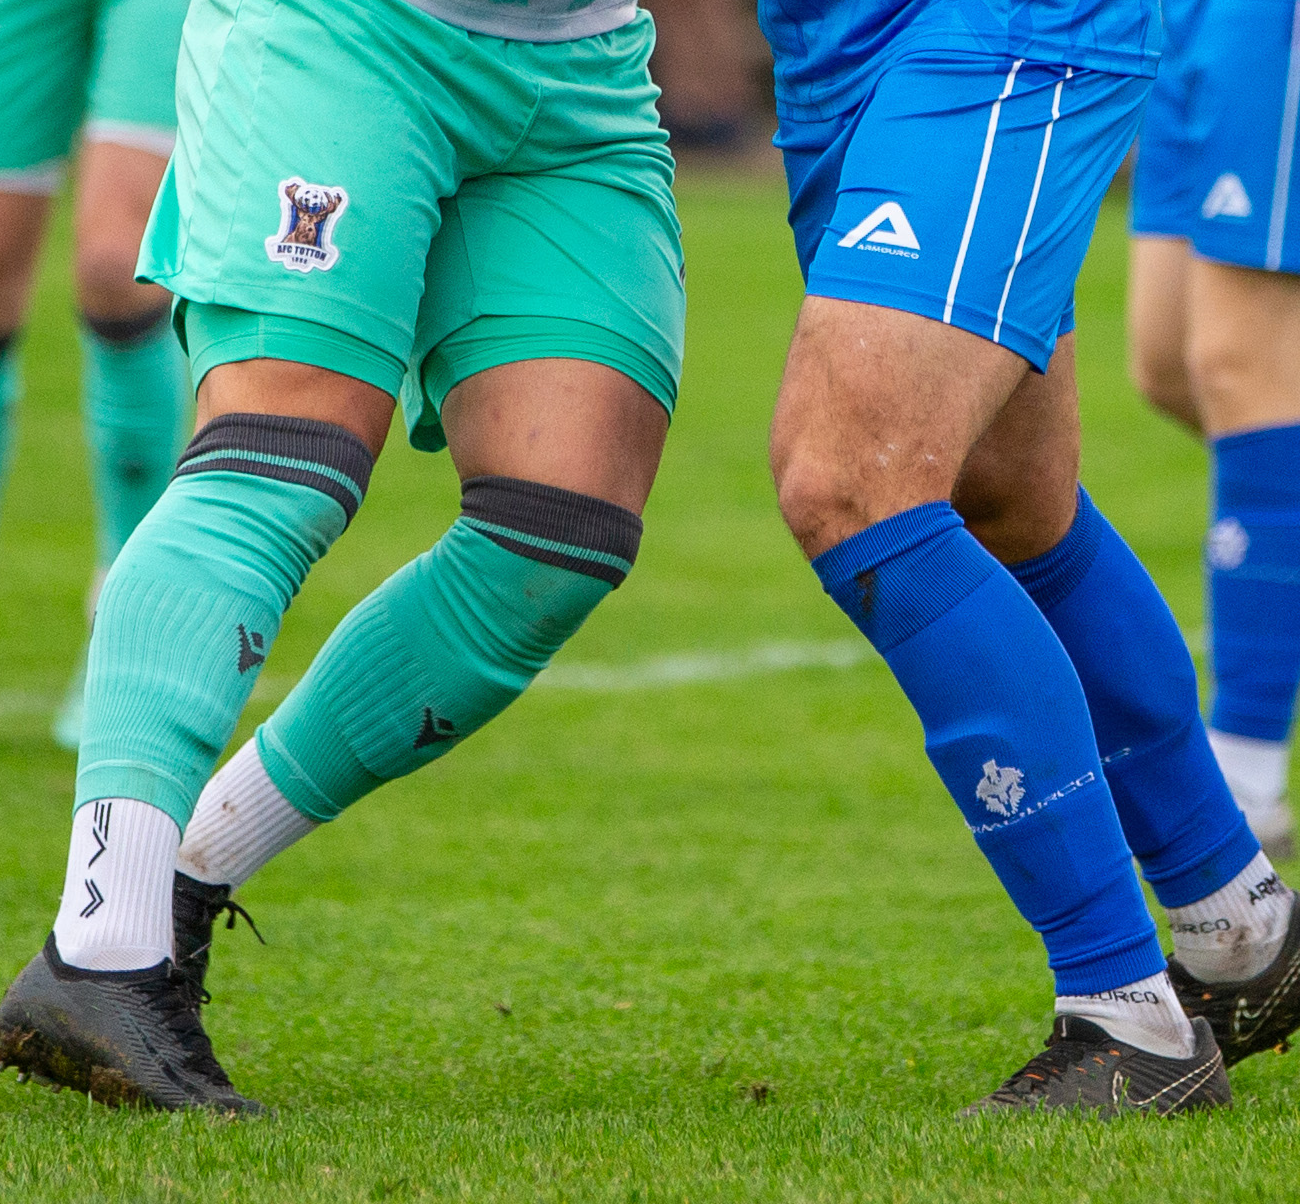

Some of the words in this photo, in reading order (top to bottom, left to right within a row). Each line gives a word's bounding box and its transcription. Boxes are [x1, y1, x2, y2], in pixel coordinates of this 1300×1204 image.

[277, 245, 293, 254] AFC
[295, 245, 327, 261] TOTTON
[857, 244, 920, 260] ARMOURCO
